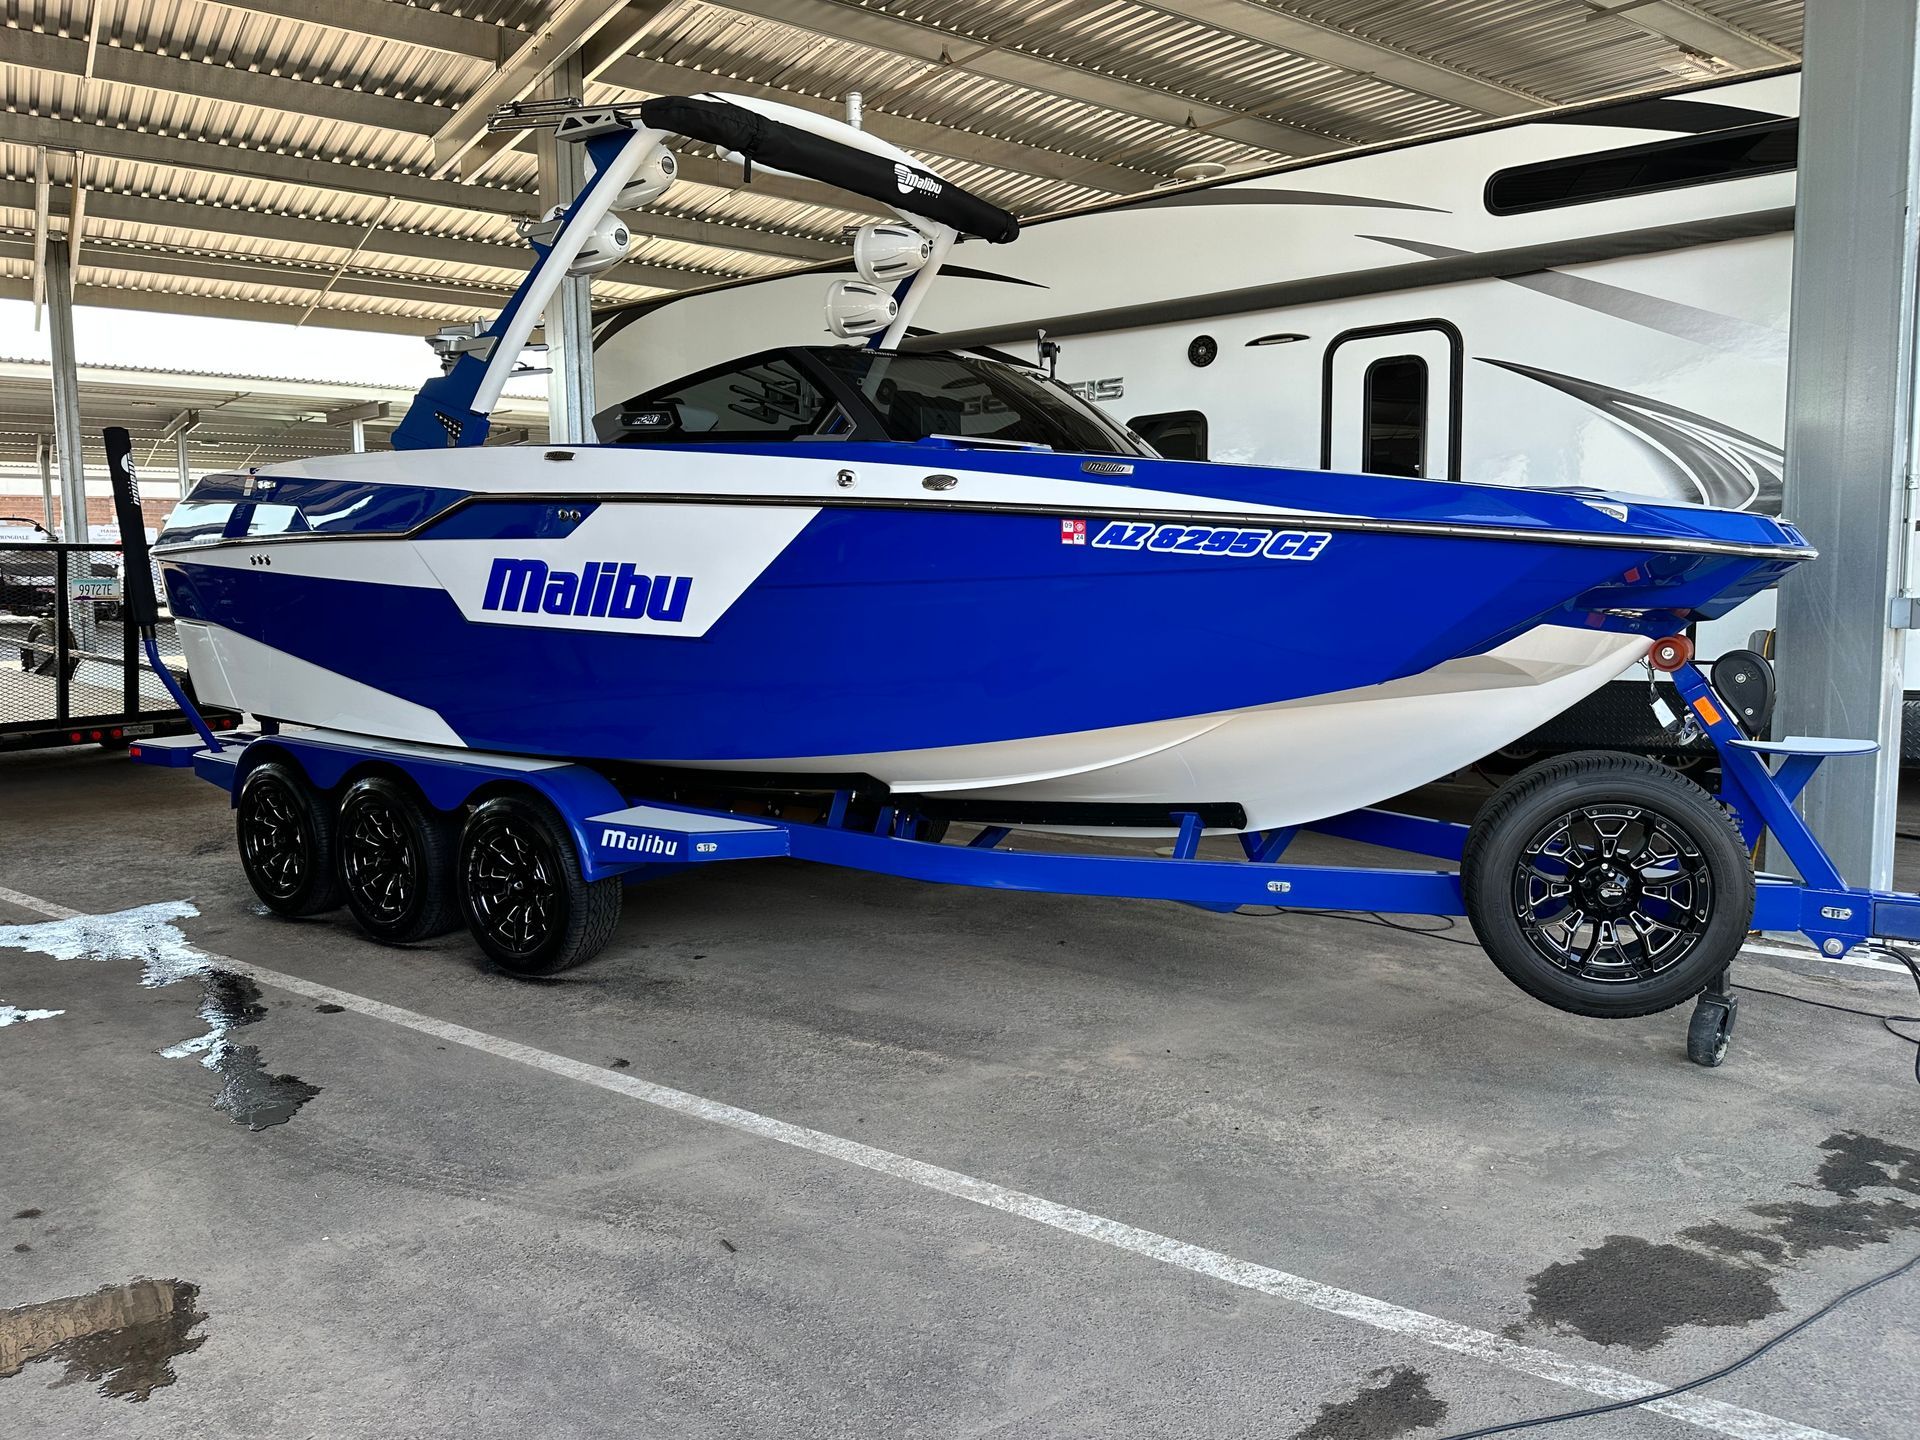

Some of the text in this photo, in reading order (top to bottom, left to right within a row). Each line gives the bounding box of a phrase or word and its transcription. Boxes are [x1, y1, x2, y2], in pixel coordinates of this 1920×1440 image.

[1092, 521, 1332, 560] AZ 8295 CE
[78, 584, 113, 596] 99727E
